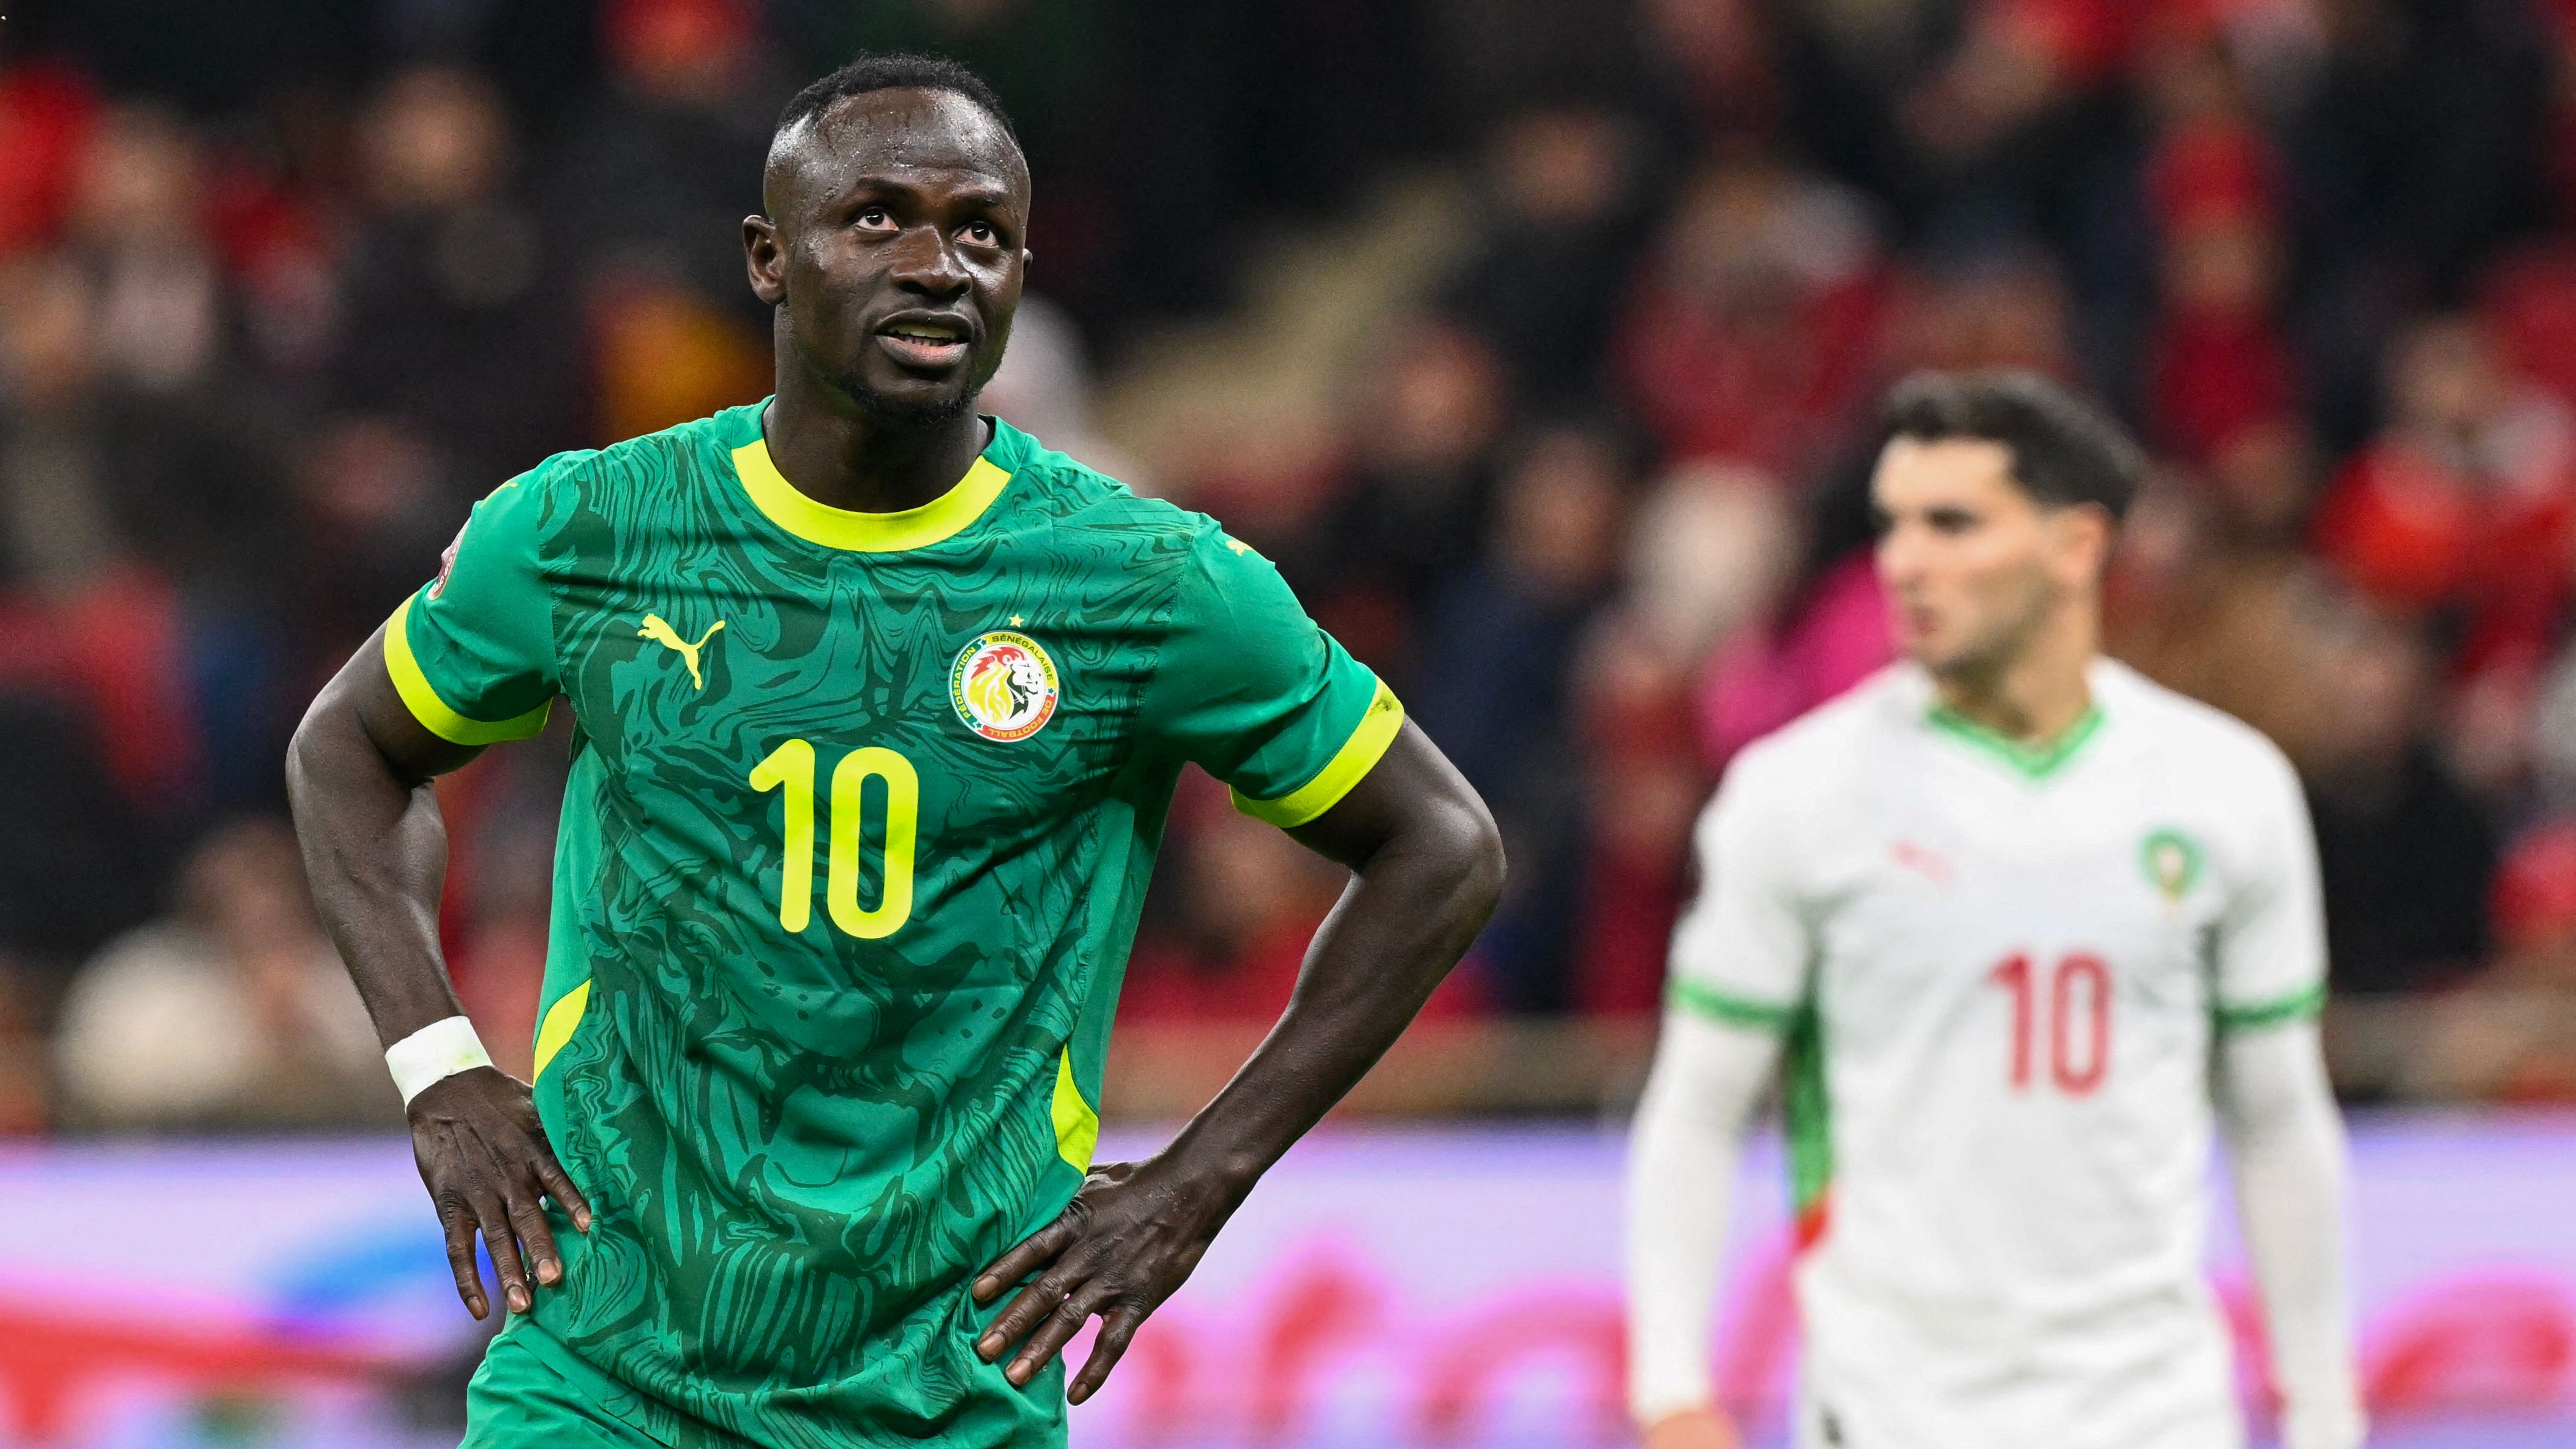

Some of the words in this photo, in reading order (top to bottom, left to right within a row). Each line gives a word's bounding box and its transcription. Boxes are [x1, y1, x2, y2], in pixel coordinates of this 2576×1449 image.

[953, 646, 976, 718] FÉDÉRATION
[992, 634, 1054, 681] SÉNÉGALAISE
[1043, 700, 1052, 715] DE
[989, 716, 1043, 738] FOOTBALL
[749, 738, 918, 939] 10
[1986, 951, 2113, 1098] 10
